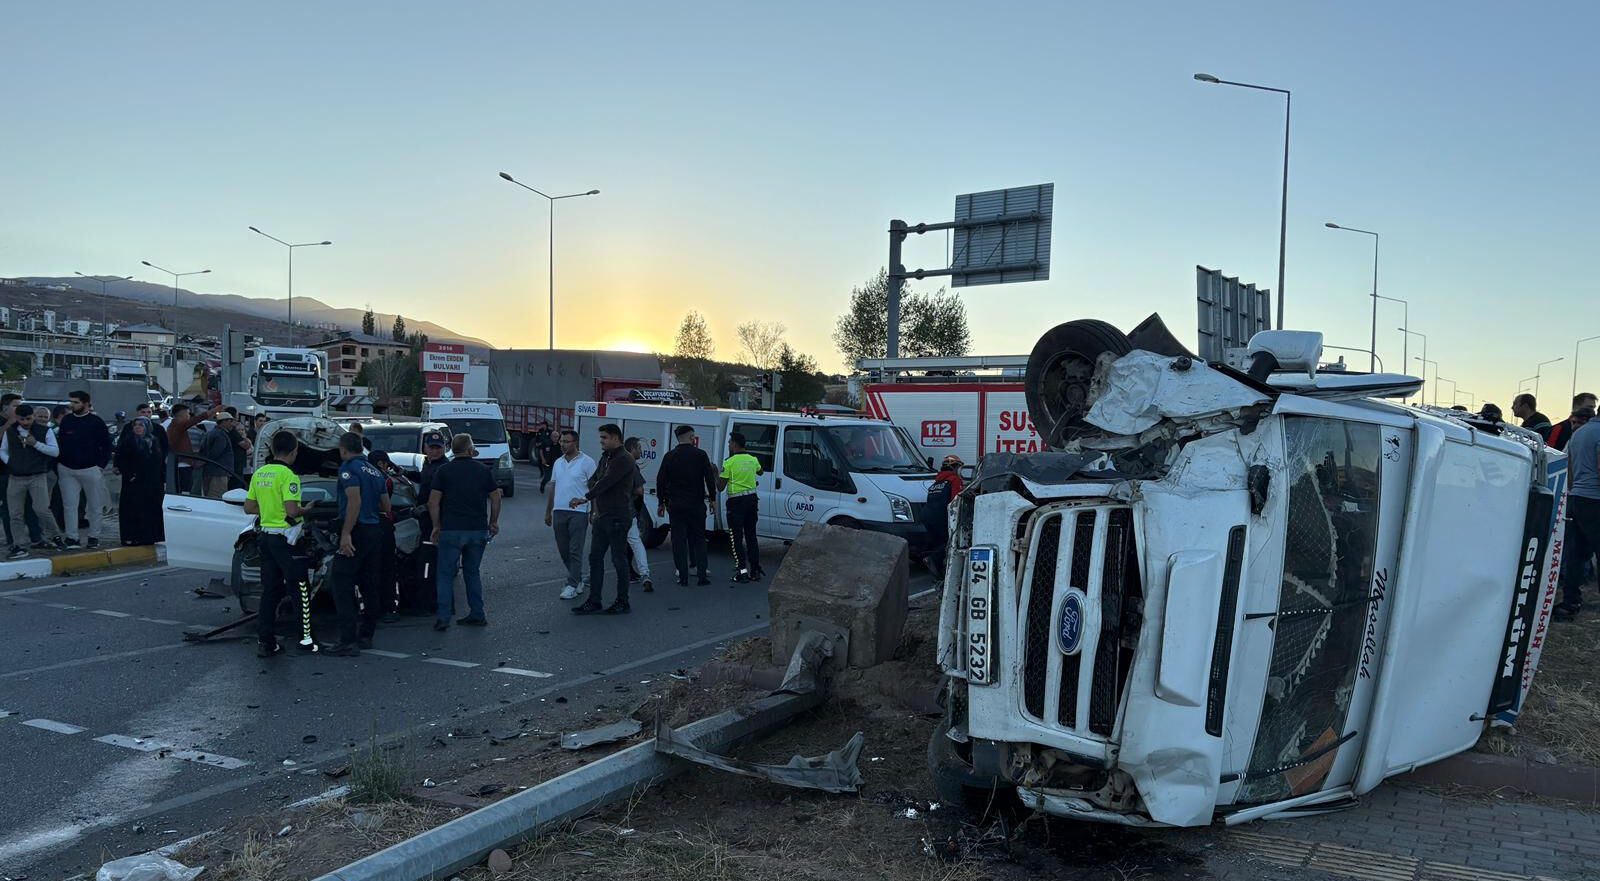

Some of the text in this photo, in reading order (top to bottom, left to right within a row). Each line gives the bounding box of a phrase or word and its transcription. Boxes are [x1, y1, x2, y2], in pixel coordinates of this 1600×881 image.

[577, 404, 596, 413] SİVAS
[926, 423, 952, 436] 112
[795, 502, 814, 512] AFAD
[1502, 537, 1539, 678] GÜLÜM
[1530, 539, 1562, 649] MAŞALLAH
[969, 562, 987, 681] 34 GB 5232
[1062, 606, 1079, 640] Ford
